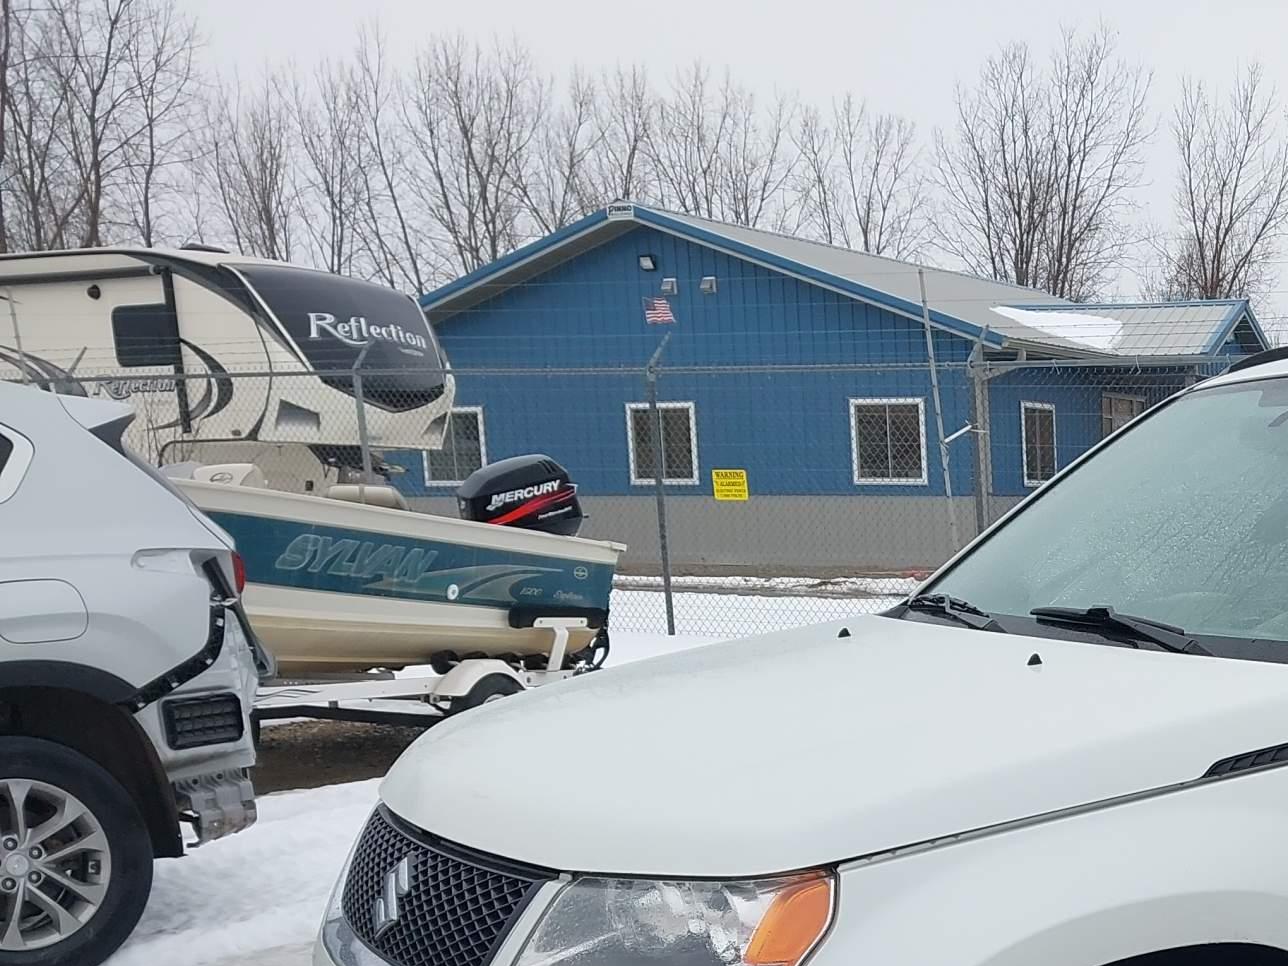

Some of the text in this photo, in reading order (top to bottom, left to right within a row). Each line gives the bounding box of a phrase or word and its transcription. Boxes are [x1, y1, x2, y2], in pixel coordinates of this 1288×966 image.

[307, 312, 427, 349] Reflection
[490, 479, 561, 506] MERCURY
[275, 533, 439, 583] SYLVAN
